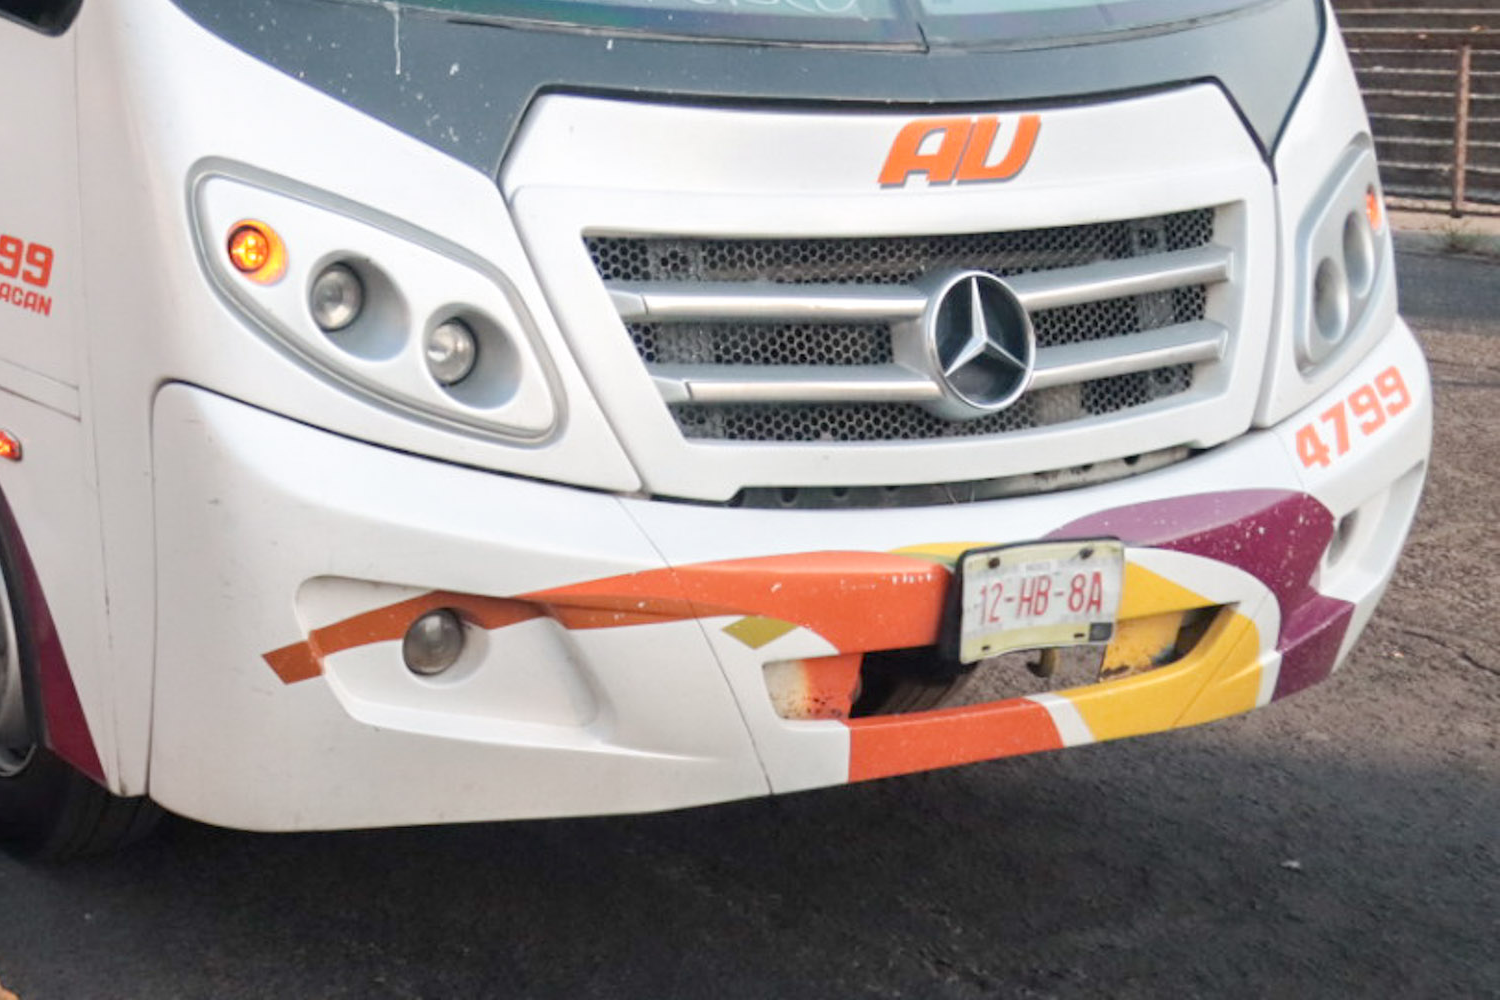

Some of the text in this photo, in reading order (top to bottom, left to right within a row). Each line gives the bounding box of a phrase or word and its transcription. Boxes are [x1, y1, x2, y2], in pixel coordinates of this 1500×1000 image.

[877, 113, 1042, 189] AU
[1295, 365, 1412, 468] 4799
[979, 571, 1104, 626] 12-HB-8A
